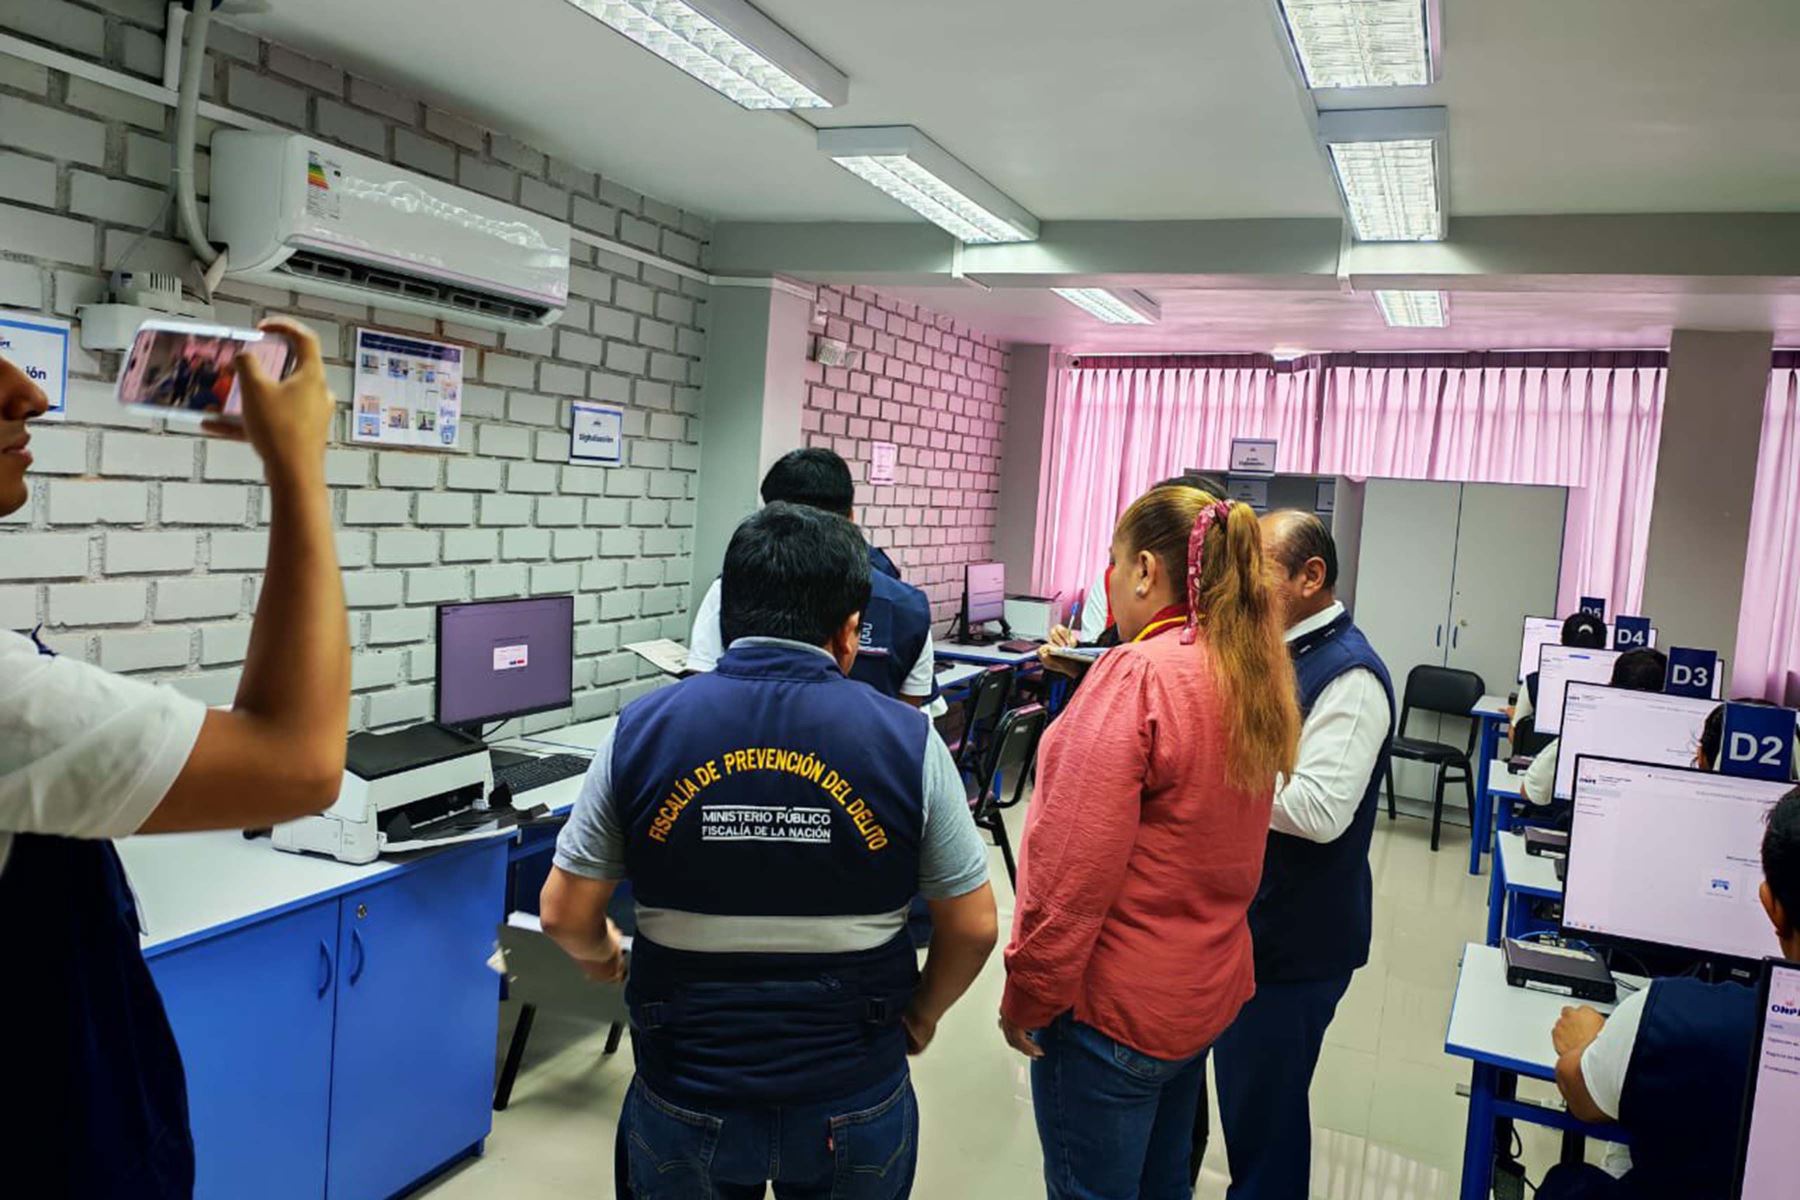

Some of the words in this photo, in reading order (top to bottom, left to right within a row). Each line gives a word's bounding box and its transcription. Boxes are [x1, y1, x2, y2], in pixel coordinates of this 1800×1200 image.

[1617, 628, 1645, 646] D4
[1671, 664, 1709, 687] D3
[1729, 731, 1784, 766] D2
[649, 778, 701, 843] FISCALÍA
[694, 760, 722, 786] DE
[723, 748, 826, 783] PREVENCIÓN
[821, 770, 852, 805] DEL
[846, 798, 888, 850] DELITO
[702, 810, 773, 823] MINISTERIO
[776, 808, 831, 825] PÚBLICO
[702, 822, 750, 837] FISCALÍA
[754, 825, 768, 837] DE
[770, 826, 786, 837] LA
[788, 824, 831, 838] NACIÓN
[1772, 1004, 1800, 1016] ONP
